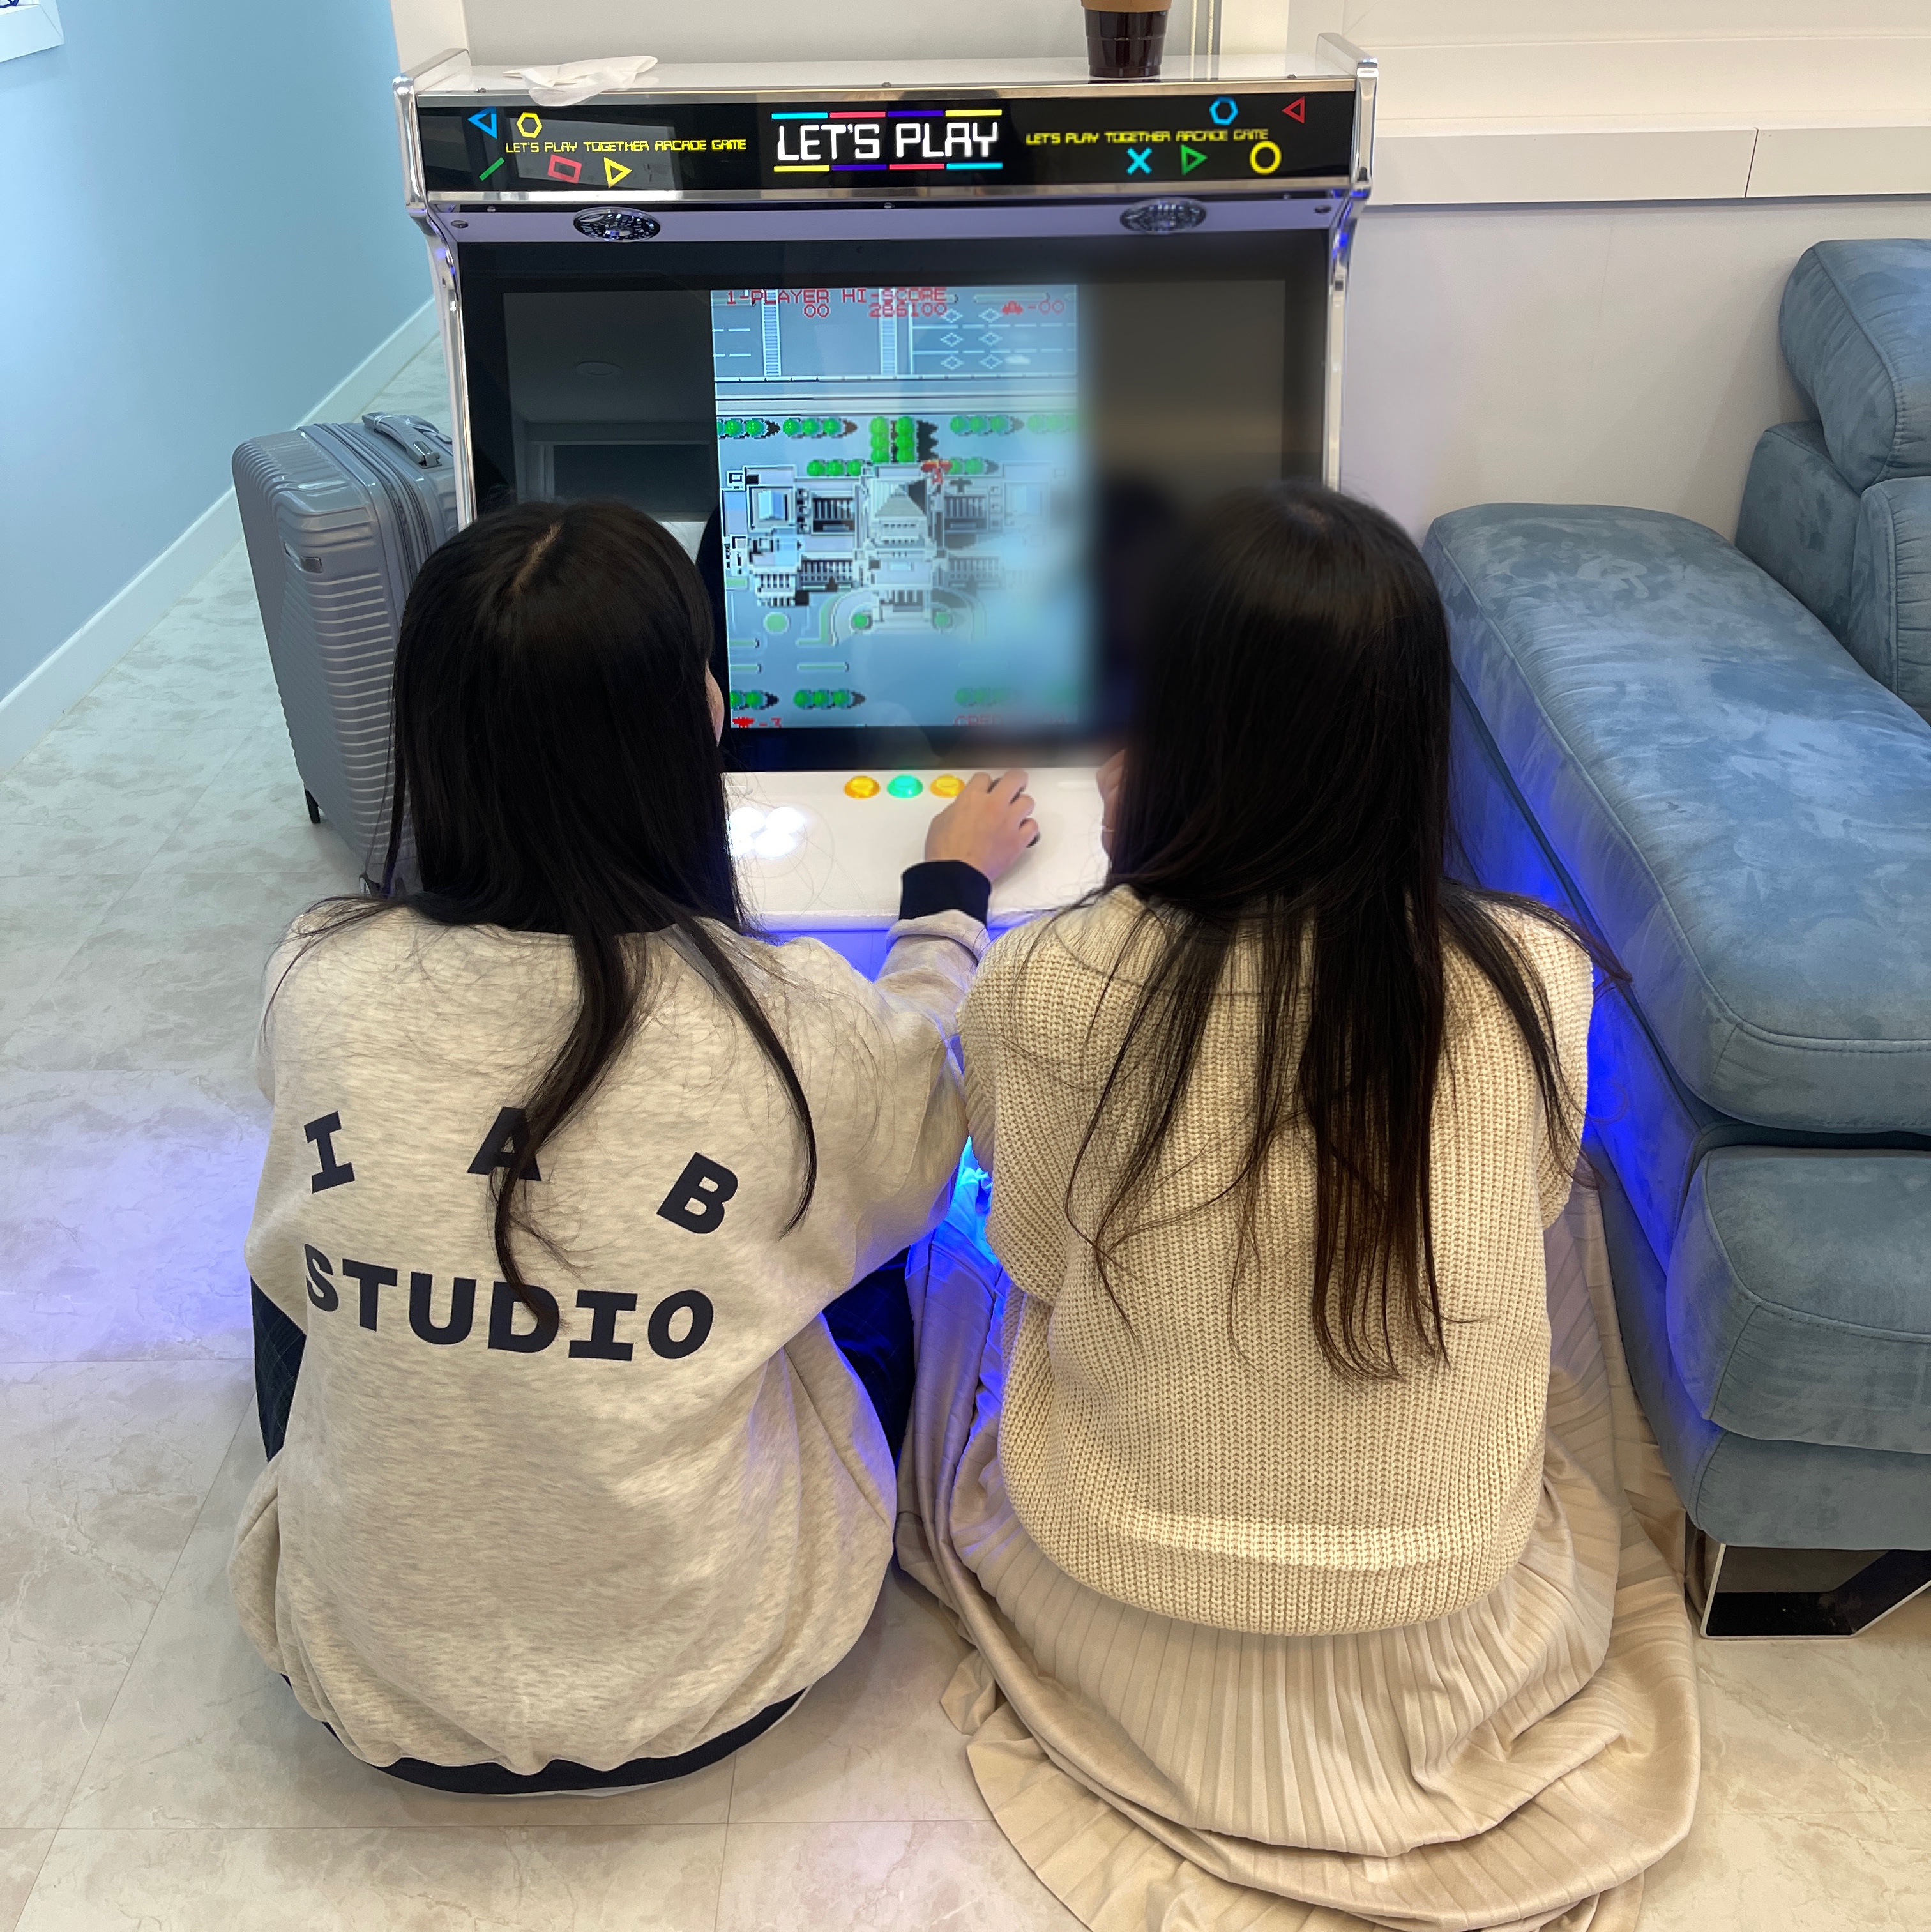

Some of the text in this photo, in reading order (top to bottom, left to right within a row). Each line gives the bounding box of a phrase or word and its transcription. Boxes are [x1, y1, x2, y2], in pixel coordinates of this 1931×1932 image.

[505, 139, 747, 153] LET'S PLAY TOGETHER ARCADE GAME
[777, 121, 998, 160] LET'S PLAY
[1064, 132, 1100, 144] PLAY
[1104, 130, 1170, 142] TOGETHER
[1175, 130, 1227, 142] ARCADE
[1233, 128, 1268, 140] GAME
[304, 1243, 715, 1362] STUDIO
